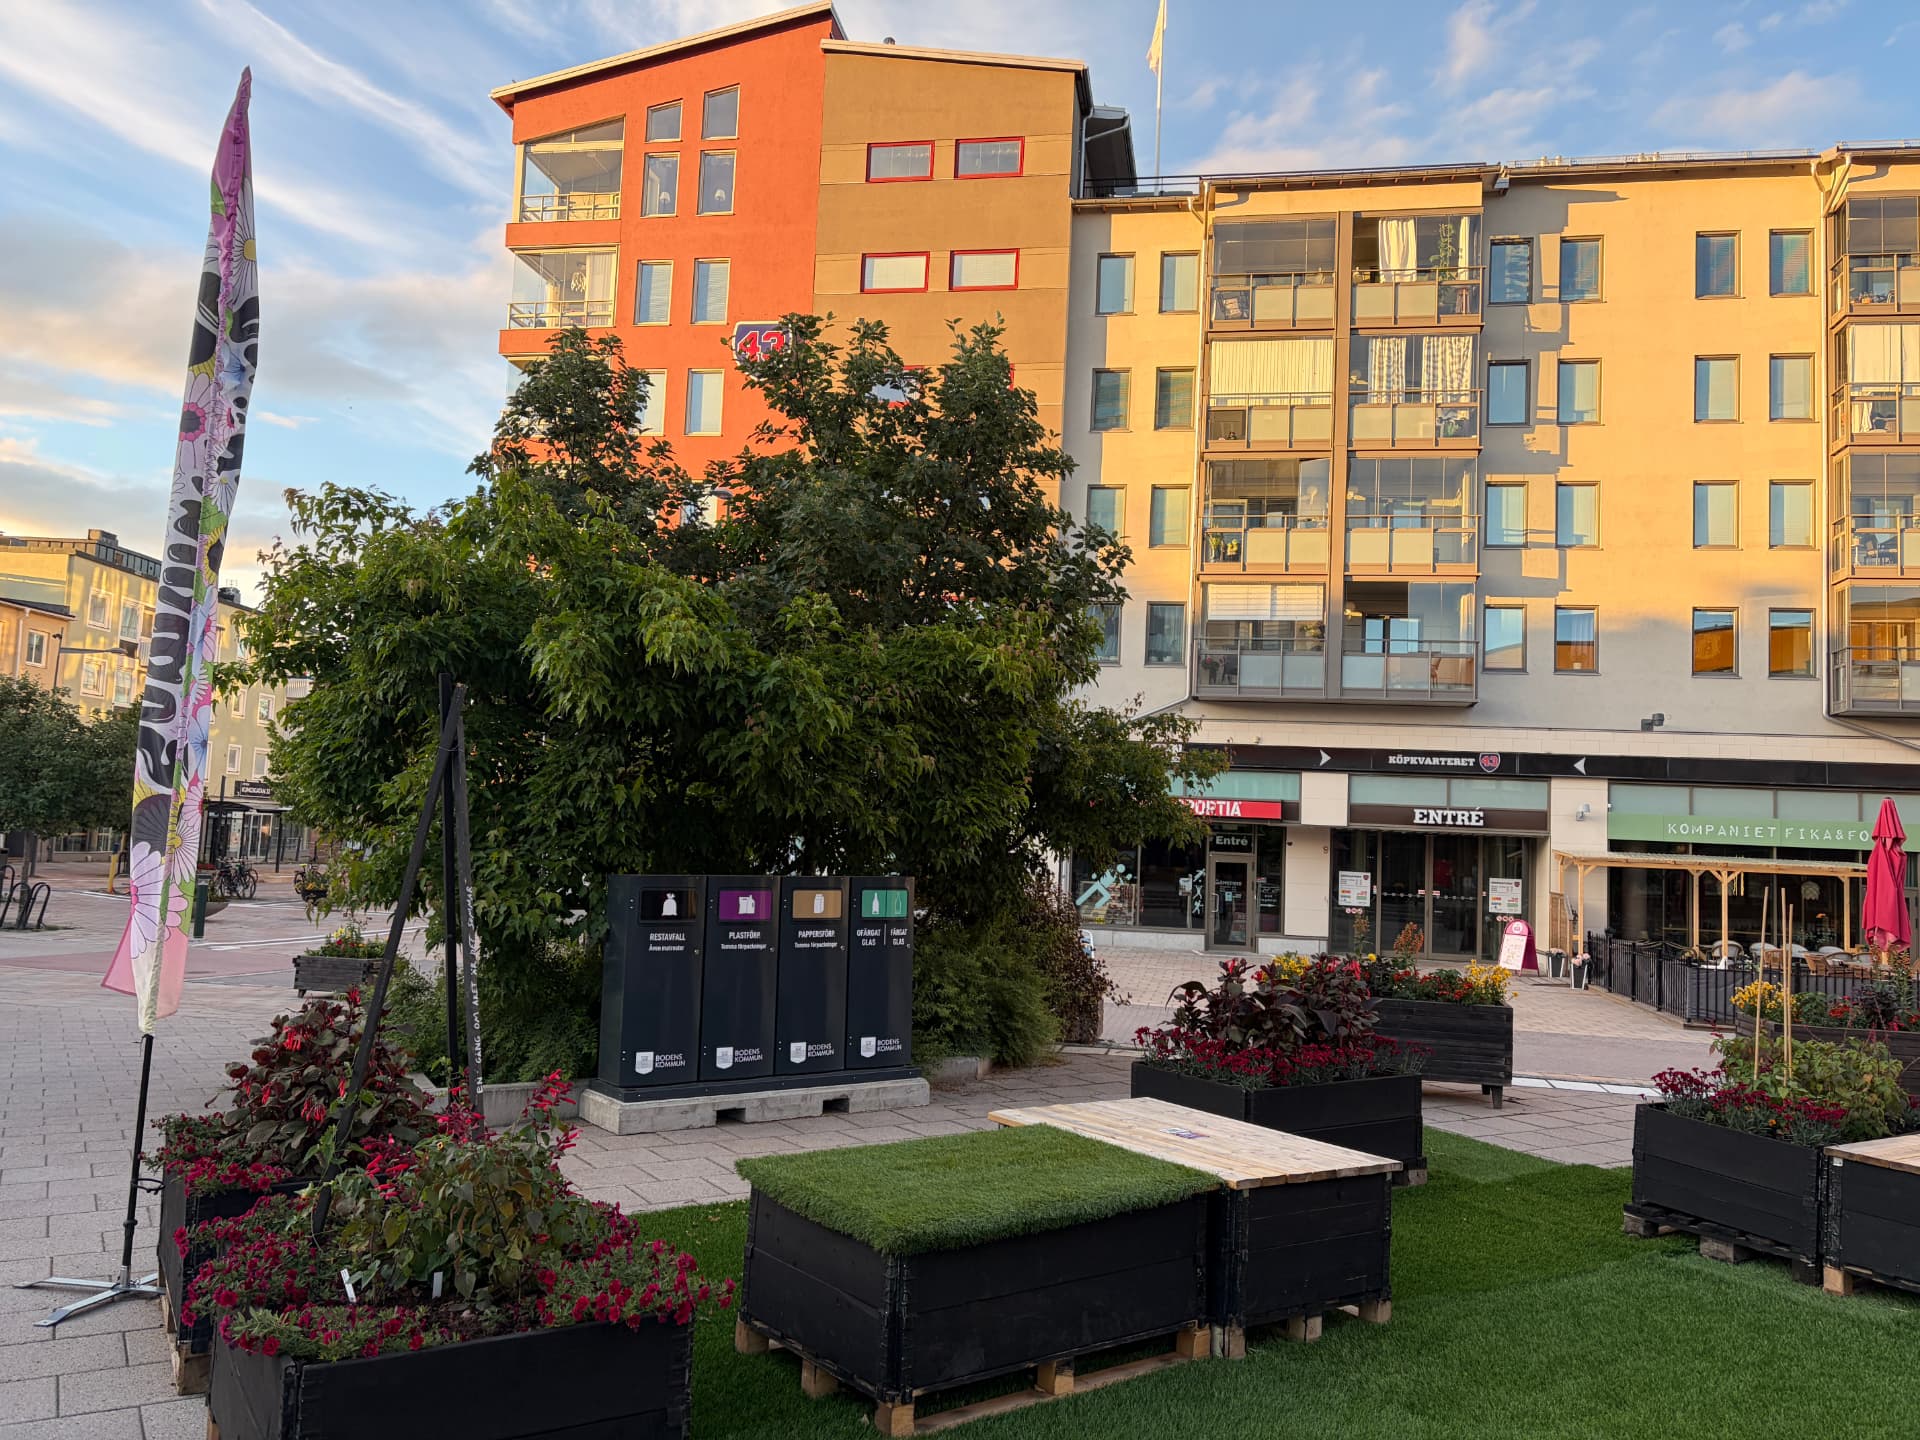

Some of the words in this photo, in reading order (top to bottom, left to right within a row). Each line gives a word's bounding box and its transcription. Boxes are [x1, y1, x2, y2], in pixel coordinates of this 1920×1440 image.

[737, 330, 786, 363] 43
[1388, 754, 1476, 767] KÖPKVARTERET
[1481, 755, 1499, 768] 43
[1413, 806, 1484, 826] ENTRÉ
[1668, 823, 1777, 839] KOMPANIET
[1215, 835, 1248, 846] Entré
[649, 932, 686, 941] RESTAVFALL
[861, 938, 876, 946] GLAS
[892, 938, 905, 946] GLAS
[472, 1011, 480, 1030] OM
[877, 1038, 900, 1046] BODENS
[807, 1043, 832, 1051] BODENS
[877, 1044, 902, 1052] KOMMUN
[734, 1048, 761, 1057] BODENS
[807, 1049, 835, 1058] KOMMUN
[655, 1053, 683, 1062] BODENS
[734, 1054, 763, 1063] KOMMUN
[655, 1060, 686, 1068] KOMMUN
